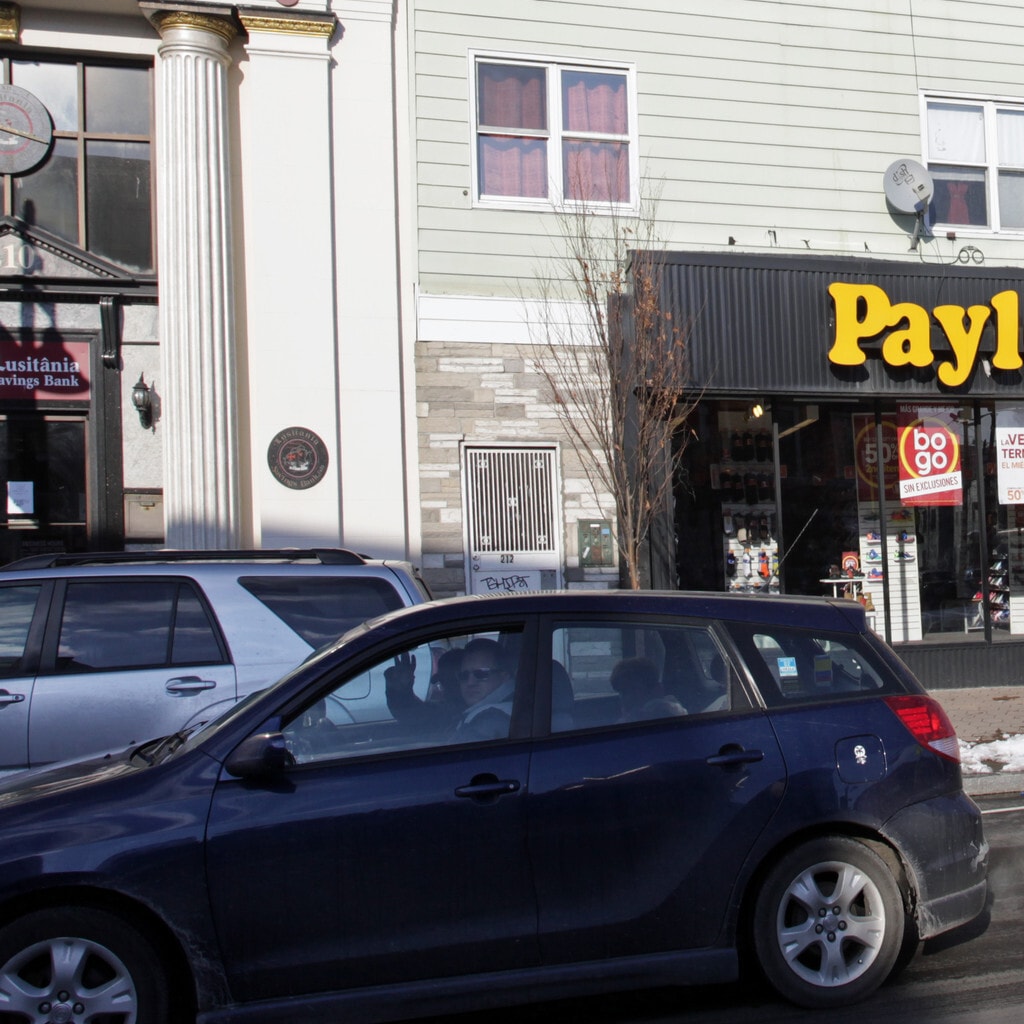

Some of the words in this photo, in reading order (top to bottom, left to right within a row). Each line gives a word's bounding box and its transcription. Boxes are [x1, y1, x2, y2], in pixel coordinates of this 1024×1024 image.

[1, 244, 35, 269] 10
[0, 356, 80, 373] usitânia
[44, 374, 80, 387] Bank
[913, 428, 947, 451] bo
[914, 451, 948, 475] go
[903, 484, 915, 494] SIN
[916, 476, 959, 491] EXCLUSIONES
[500, 554, 514, 564] 212
